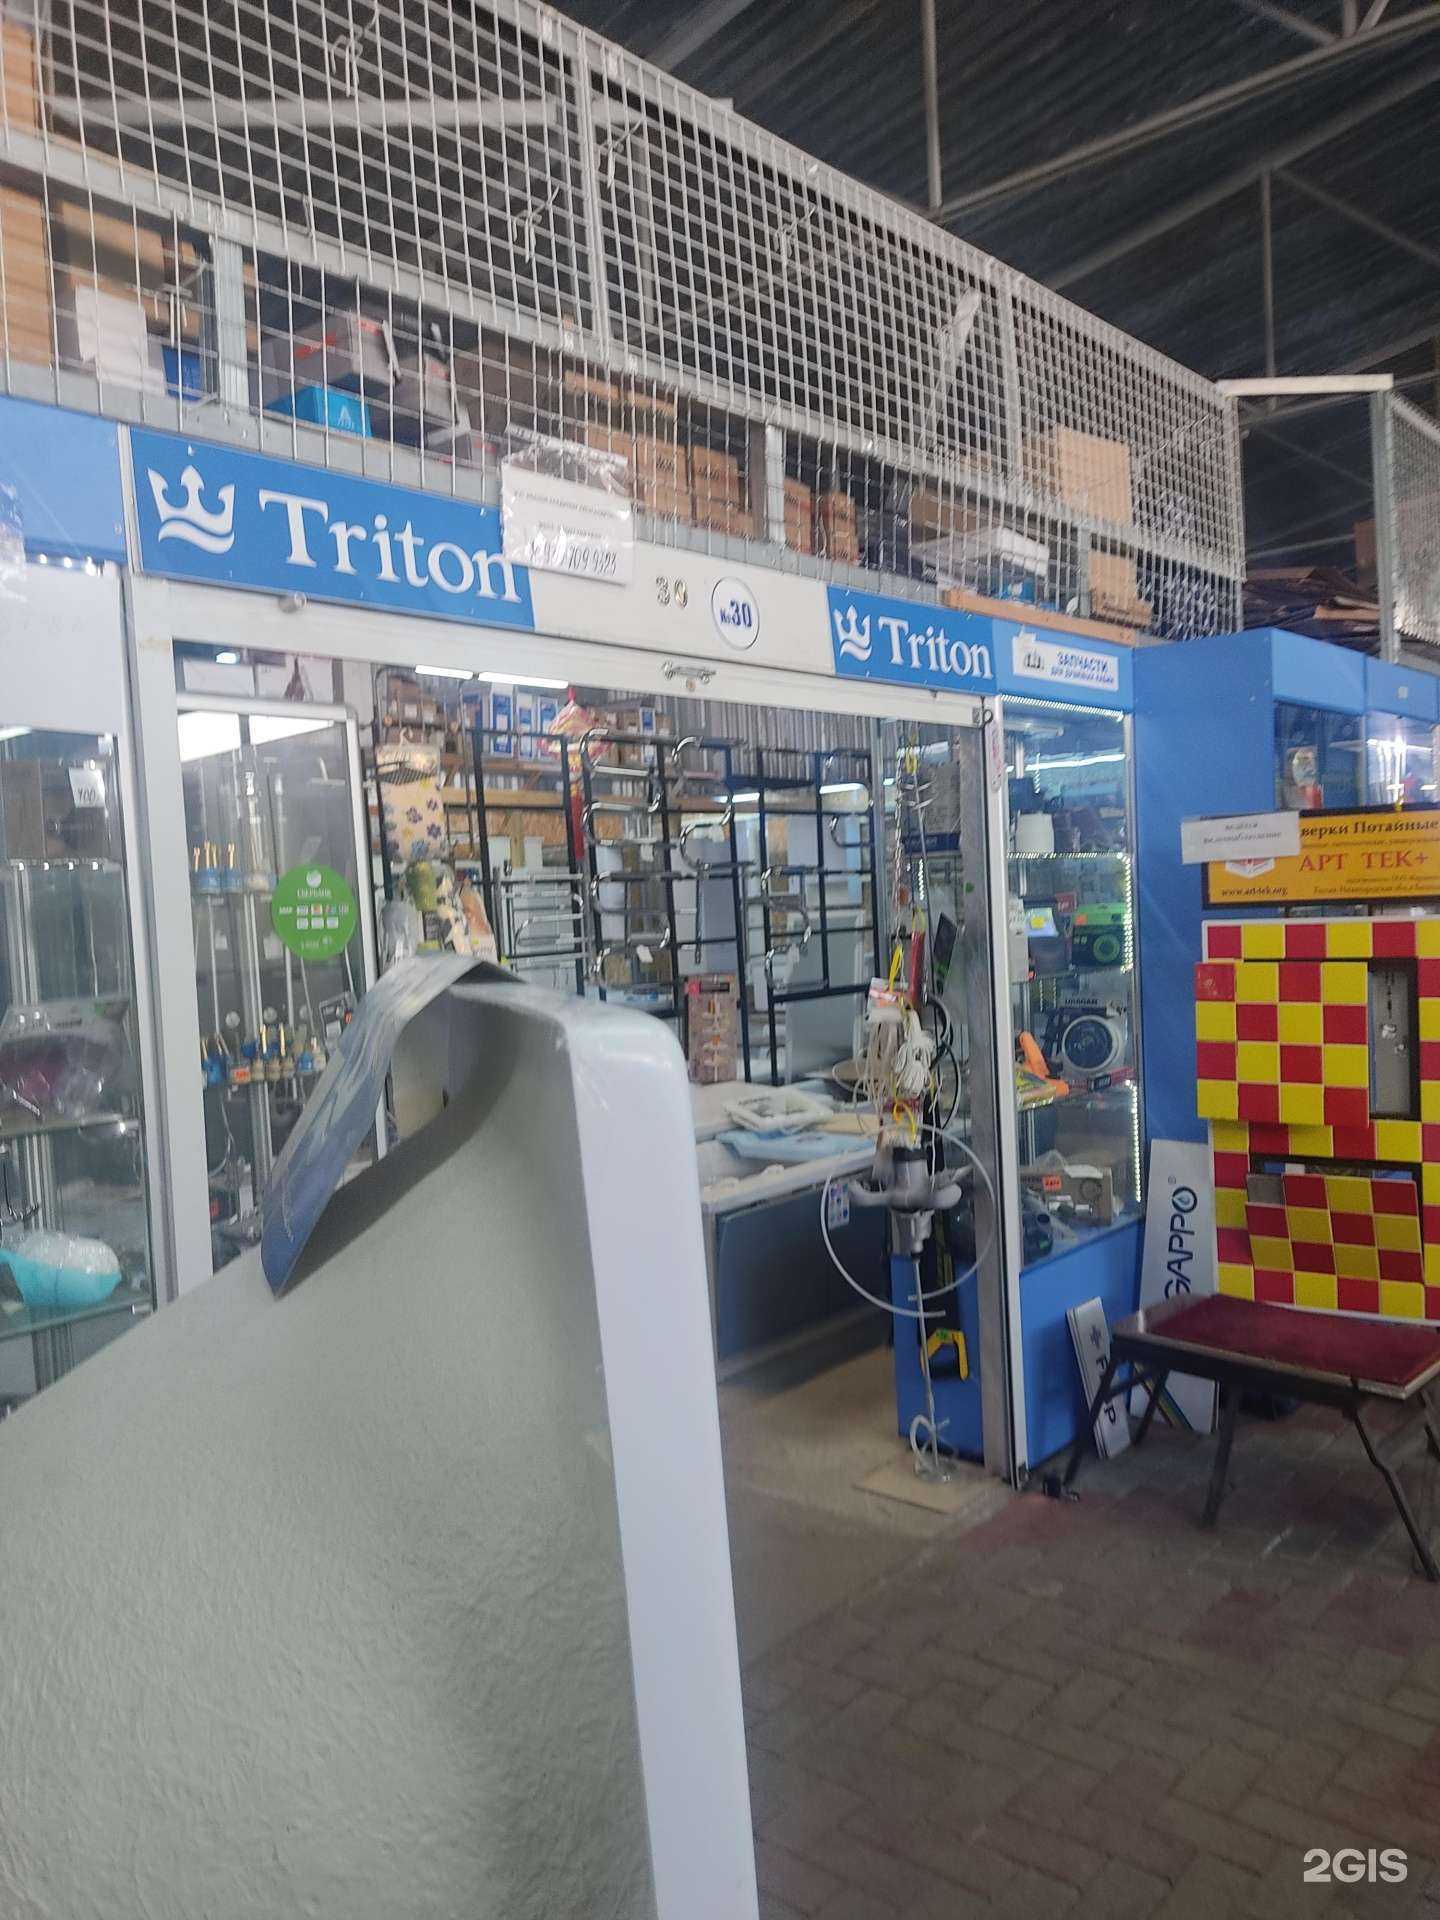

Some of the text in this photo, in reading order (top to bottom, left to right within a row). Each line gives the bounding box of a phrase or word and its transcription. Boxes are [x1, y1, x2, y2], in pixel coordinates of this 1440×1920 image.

[258, 487, 522, 603] Triton
[878, 616, 994, 680] Triton
[1057, 651, 1108, 672] ЗАПЧАСТИ
[1301, 824, 1350, 840] верки
